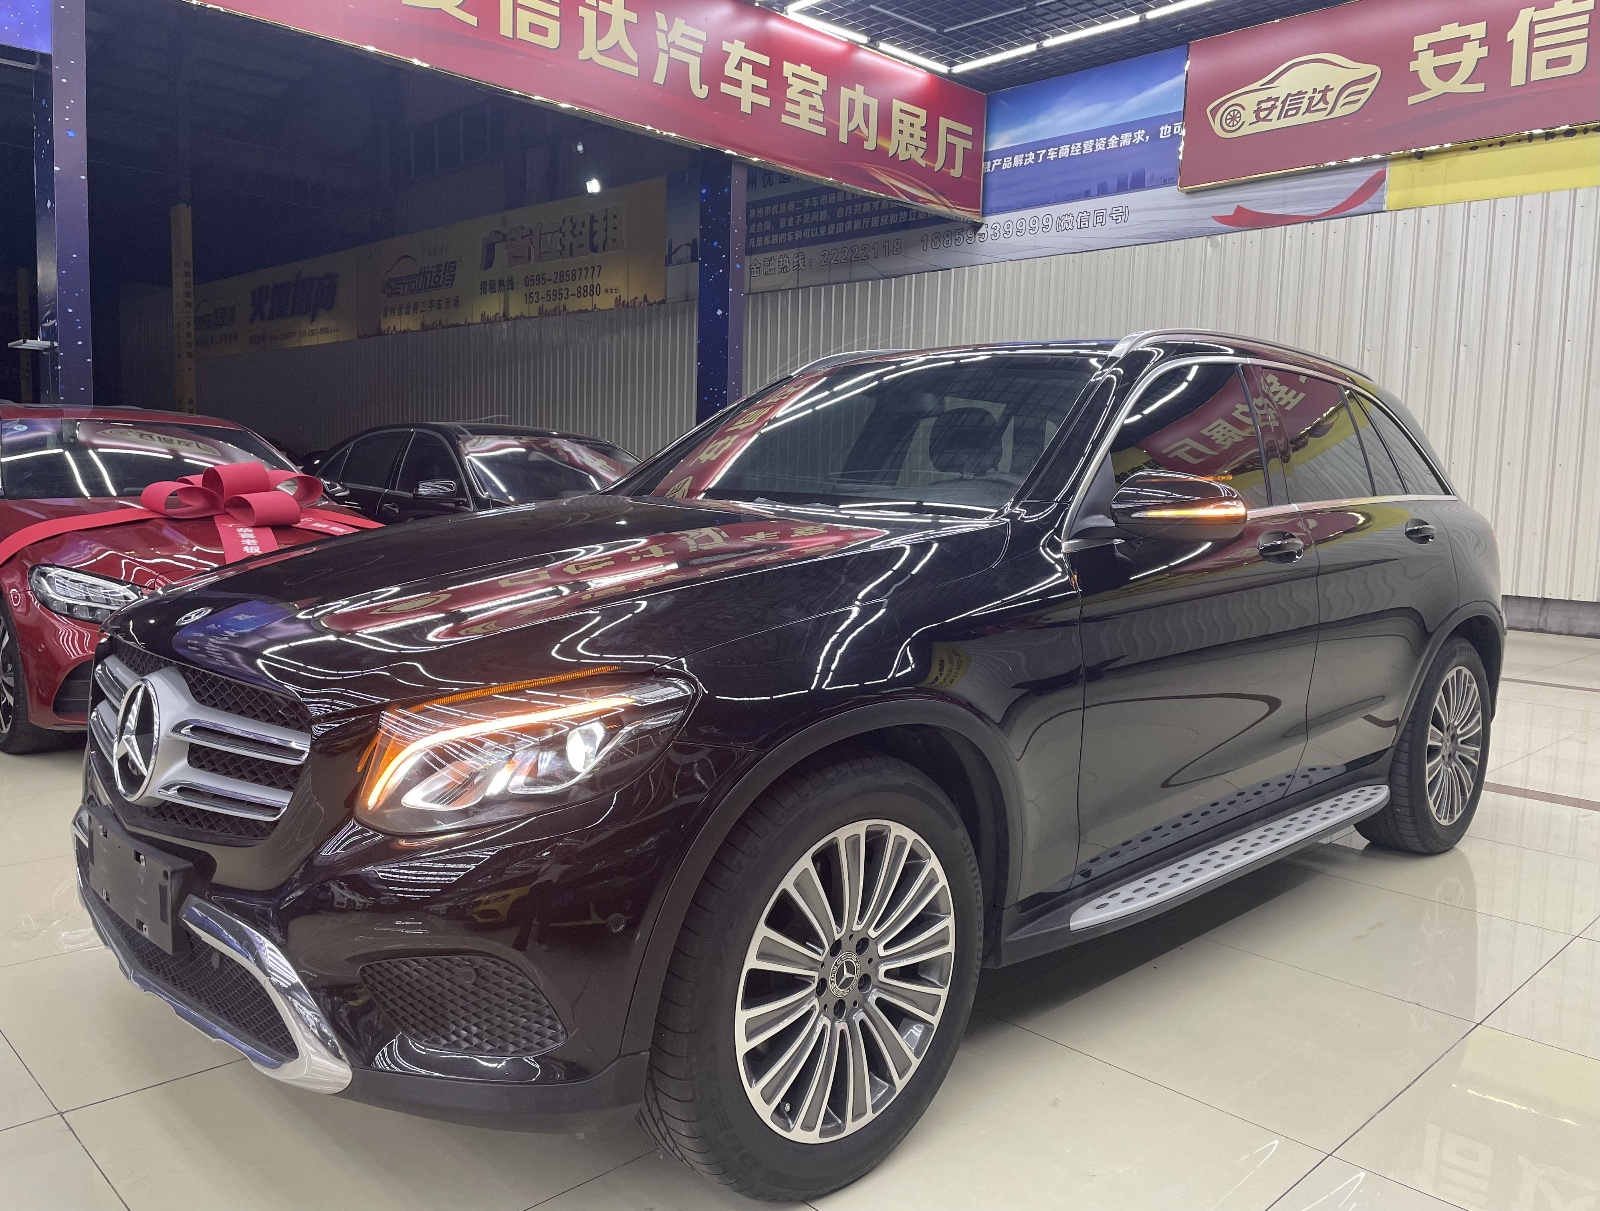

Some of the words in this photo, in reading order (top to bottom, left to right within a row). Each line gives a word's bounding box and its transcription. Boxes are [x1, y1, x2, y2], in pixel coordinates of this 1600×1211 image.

[402, 0, 974, 179] 信达汽车室内展厅
[1249, 84, 1334, 126] 安信达
